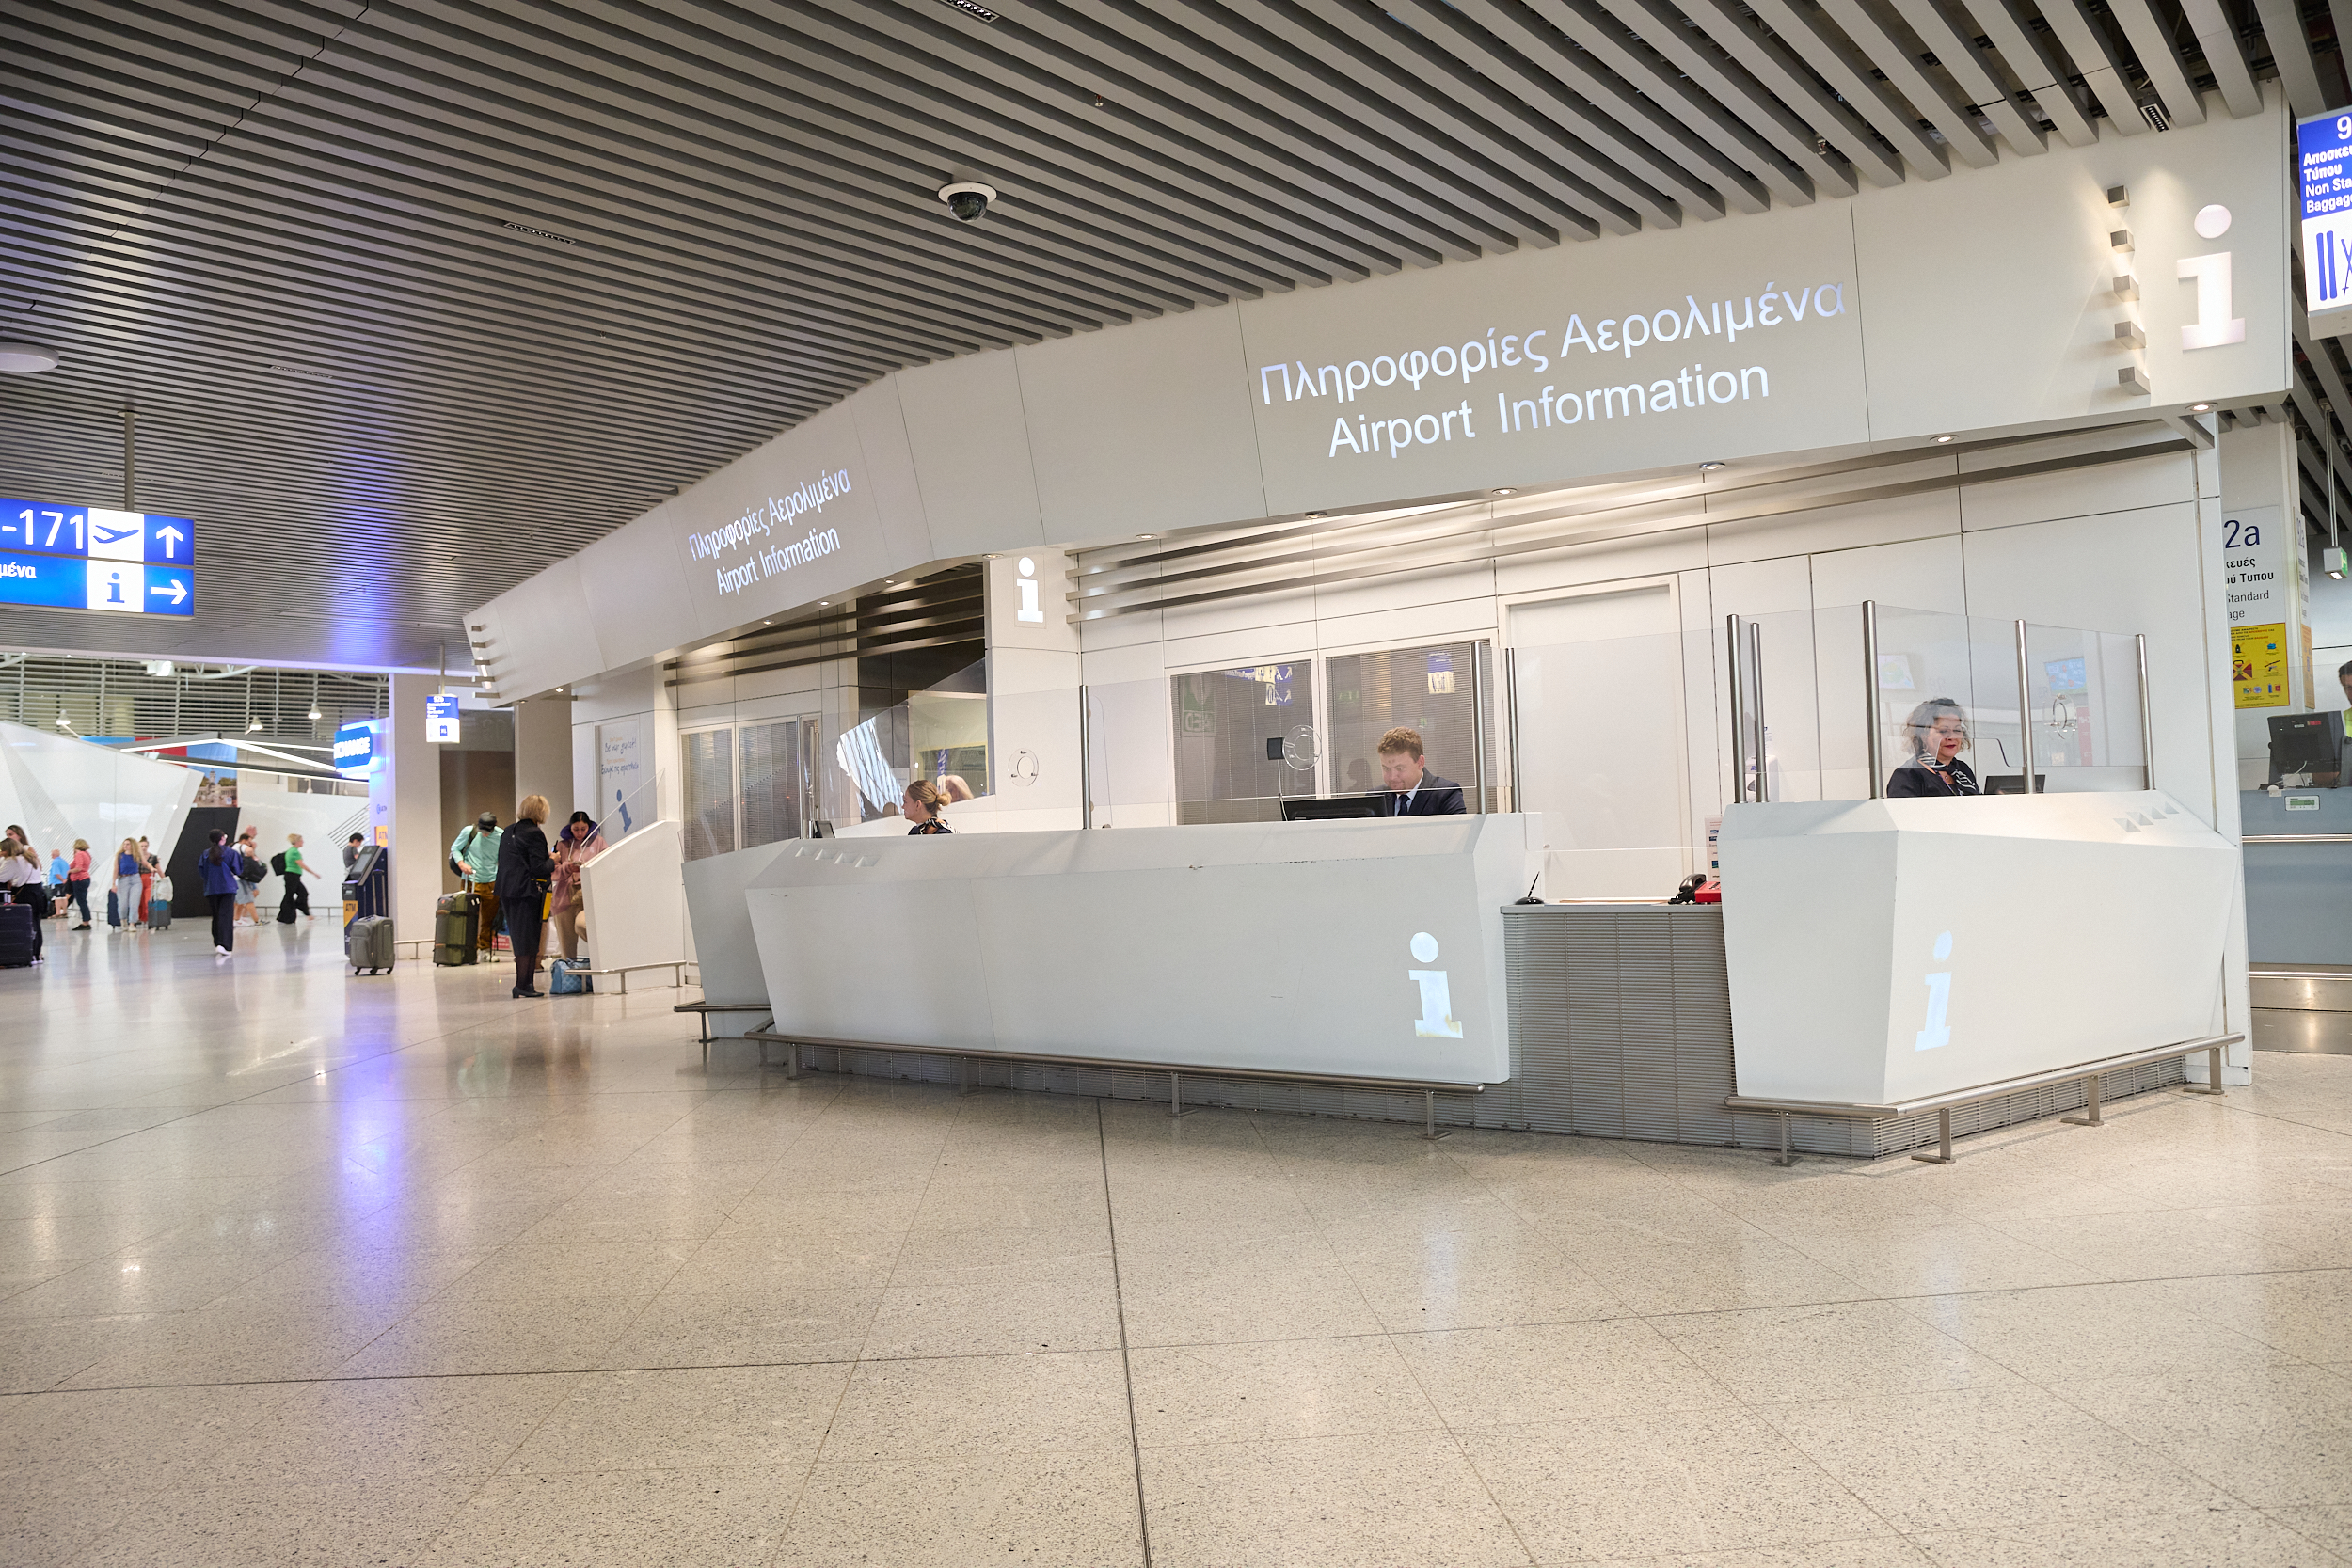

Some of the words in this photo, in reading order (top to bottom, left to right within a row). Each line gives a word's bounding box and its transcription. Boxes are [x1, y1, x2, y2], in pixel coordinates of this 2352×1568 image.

[2303, 163, 2343, 182] Τύπου
[2305, 182, 2330, 198] Non
[1260, 326, 1549, 405] Πληροφορίες
[1560, 281, 1847, 358] Αερολιμένα
[1327, 399, 1476, 459] Airport
[1497, 363, 1771, 434] Information
[689, 507, 770, 561] Πληροφορίες
[768, 468, 851, 526] Αερολιμένα
[2223, 519, 2261, 549] 2a
[716, 556, 759, 595] Airport
[759, 527, 841, 578] Information
[2239, 572, 2274, 583] Τυπου
